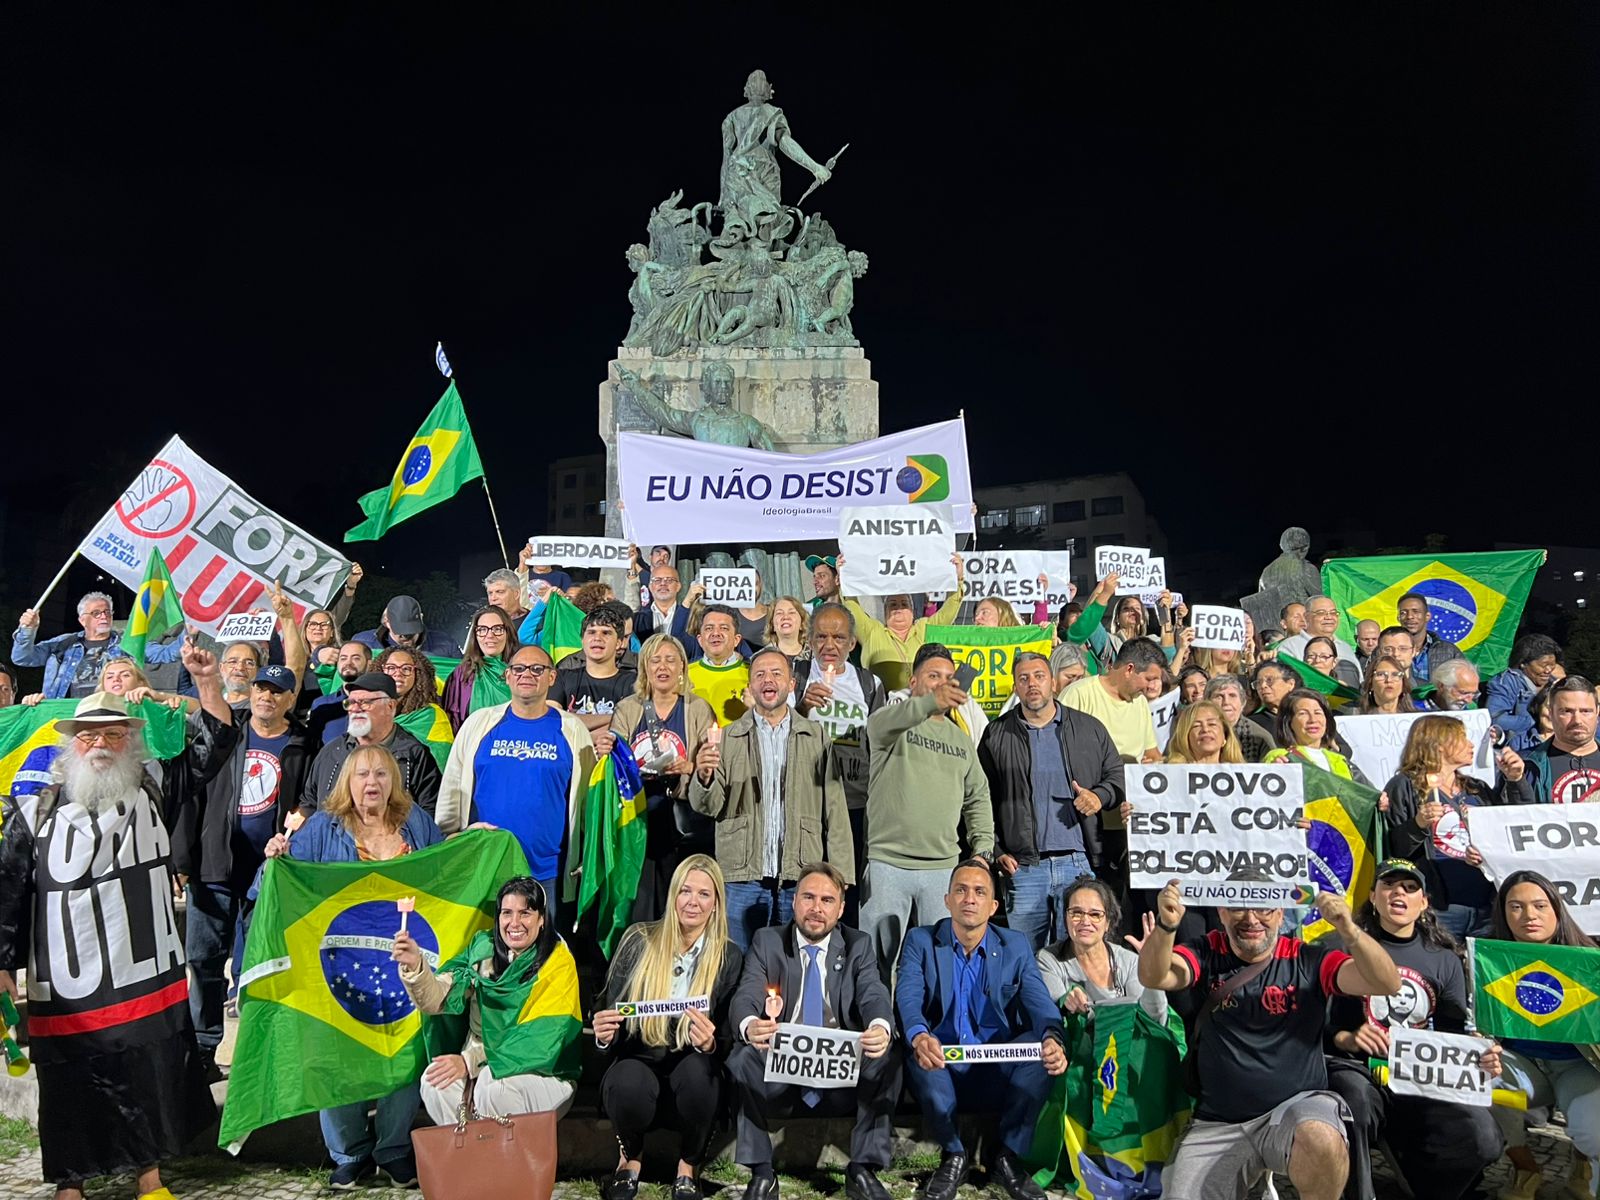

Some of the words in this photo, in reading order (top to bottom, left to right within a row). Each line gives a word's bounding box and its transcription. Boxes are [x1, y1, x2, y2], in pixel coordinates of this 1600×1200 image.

[646, 475, 691, 501] EU
[700, 467, 772, 500] NÃO
[762, 506, 832, 517] IdeologiaBrasil
[848, 518, 943, 536] ANISTIA
[92, 536, 141, 570] BRASIL!
[196, 489, 343, 610] FORA
[1099, 551, 1146, 565] FORA
[878, 555, 916, 577] JÁ!
[961, 557, 1018, 575] ORA
[1099, 562, 1146, 580] MORAES!
[702, 575, 753, 588] FORA
[962, 578, 1043, 598] ORAES!
[702, 588, 753, 602] LULA!
[226, 615, 273, 627] FORA
[1195, 613, 1244, 629] FORA
[219, 624, 272, 637] MORAES!
[1194, 626, 1244, 643] LULA!
[815, 700, 864, 720] ORA
[493, 739, 531, 749] BRASIL
[533, 741, 557, 752] COM
[906, 730, 968, 760] CATERPILLAR
[1142, 771, 1169, 795] O
[1188, 771, 1287, 797] POVO
[1130, 803, 1217, 835] ESTÁ
[1230, 806, 1304, 831] COM
[35, 787, 171, 884] ORA
[1129, 849, 1307, 878] BOLSONARO!
[1184, 886, 1203, 898] EU
[1206, 883, 1237, 898] NÃO
[326, 937, 360, 947] ORDEM
[638, 1003, 654, 1014] NÓS
[655, 998, 708, 1013] VENCEREMOS!
[774, 1032, 856, 1058] FORA
[965, 1047, 982, 1059] NÓS
[983, 1047, 1041, 1059] VENCEREMOS!
[1394, 1040, 1481, 1068] FORA
[771, 1052, 856, 1081] MORAES!
[1394, 1061, 1486, 1093] LULA!
